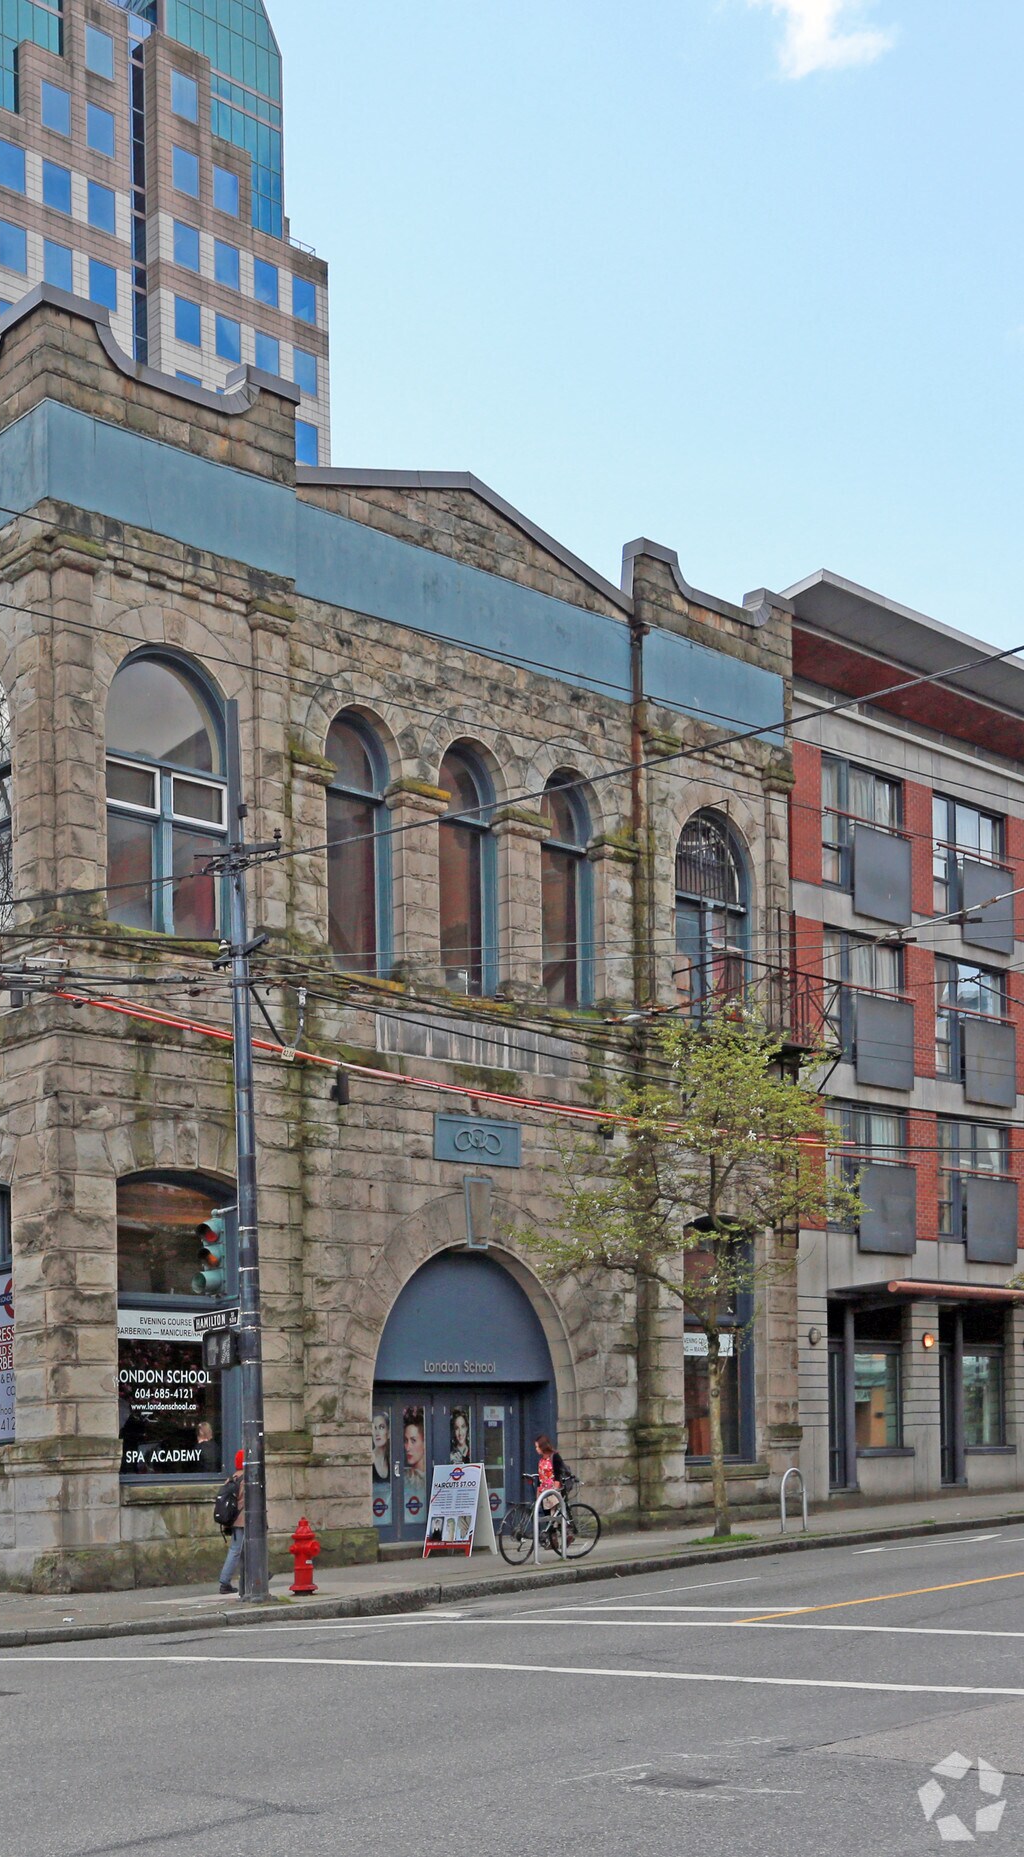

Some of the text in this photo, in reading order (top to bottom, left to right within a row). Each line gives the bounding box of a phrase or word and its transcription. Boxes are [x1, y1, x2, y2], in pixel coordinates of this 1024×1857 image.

[139, 1317, 192, 1327] EVENING COURSE
[195, 1313, 226, 1331] HAMILTON
[117, 1326, 152, 1336] BARBERING
[424, 1360, 496, 1373] London School
[118, 1370, 212, 1384] ONDON SCHOOL
[134, 1388, 194, 1399] 604-685-4121
[126, 1449, 203, 1463] SPA ACADEMY
[434, 1480, 477, 1489] HAIRCUTS $7.00
